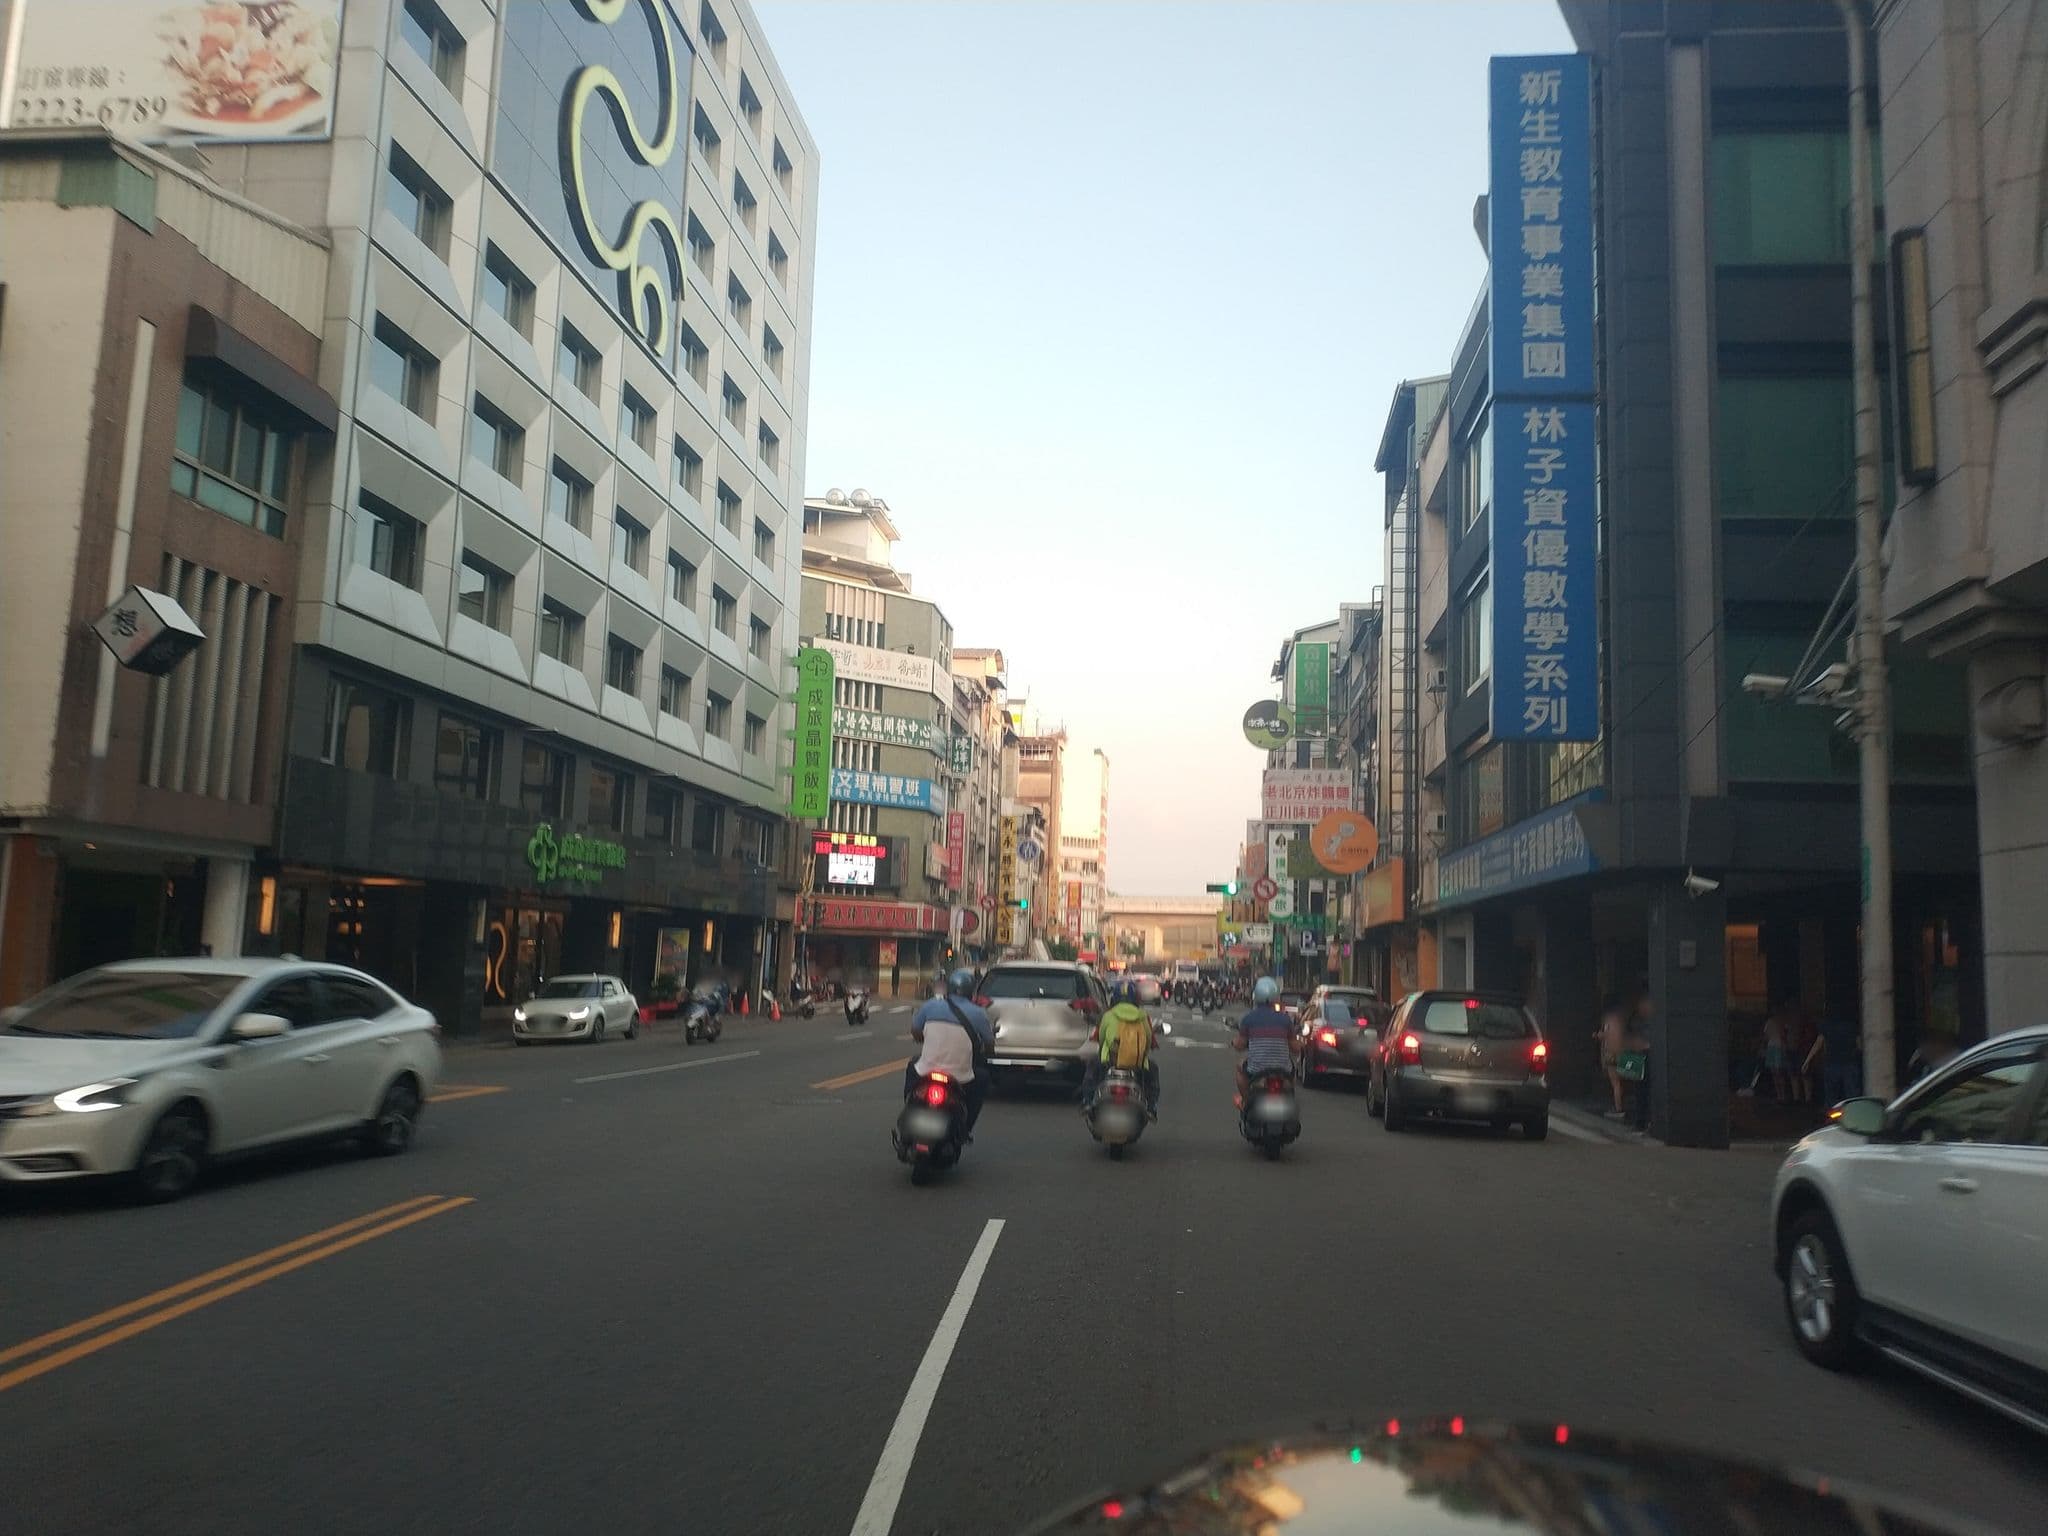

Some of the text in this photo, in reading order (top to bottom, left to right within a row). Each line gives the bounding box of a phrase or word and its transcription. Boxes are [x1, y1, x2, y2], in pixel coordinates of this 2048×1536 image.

[15, 96, 167, 125] 2223-6789
[1519, 69, 1566, 378] 新生教育事業集團
[1522, 406, 1569, 735] 林子資優數學系列
